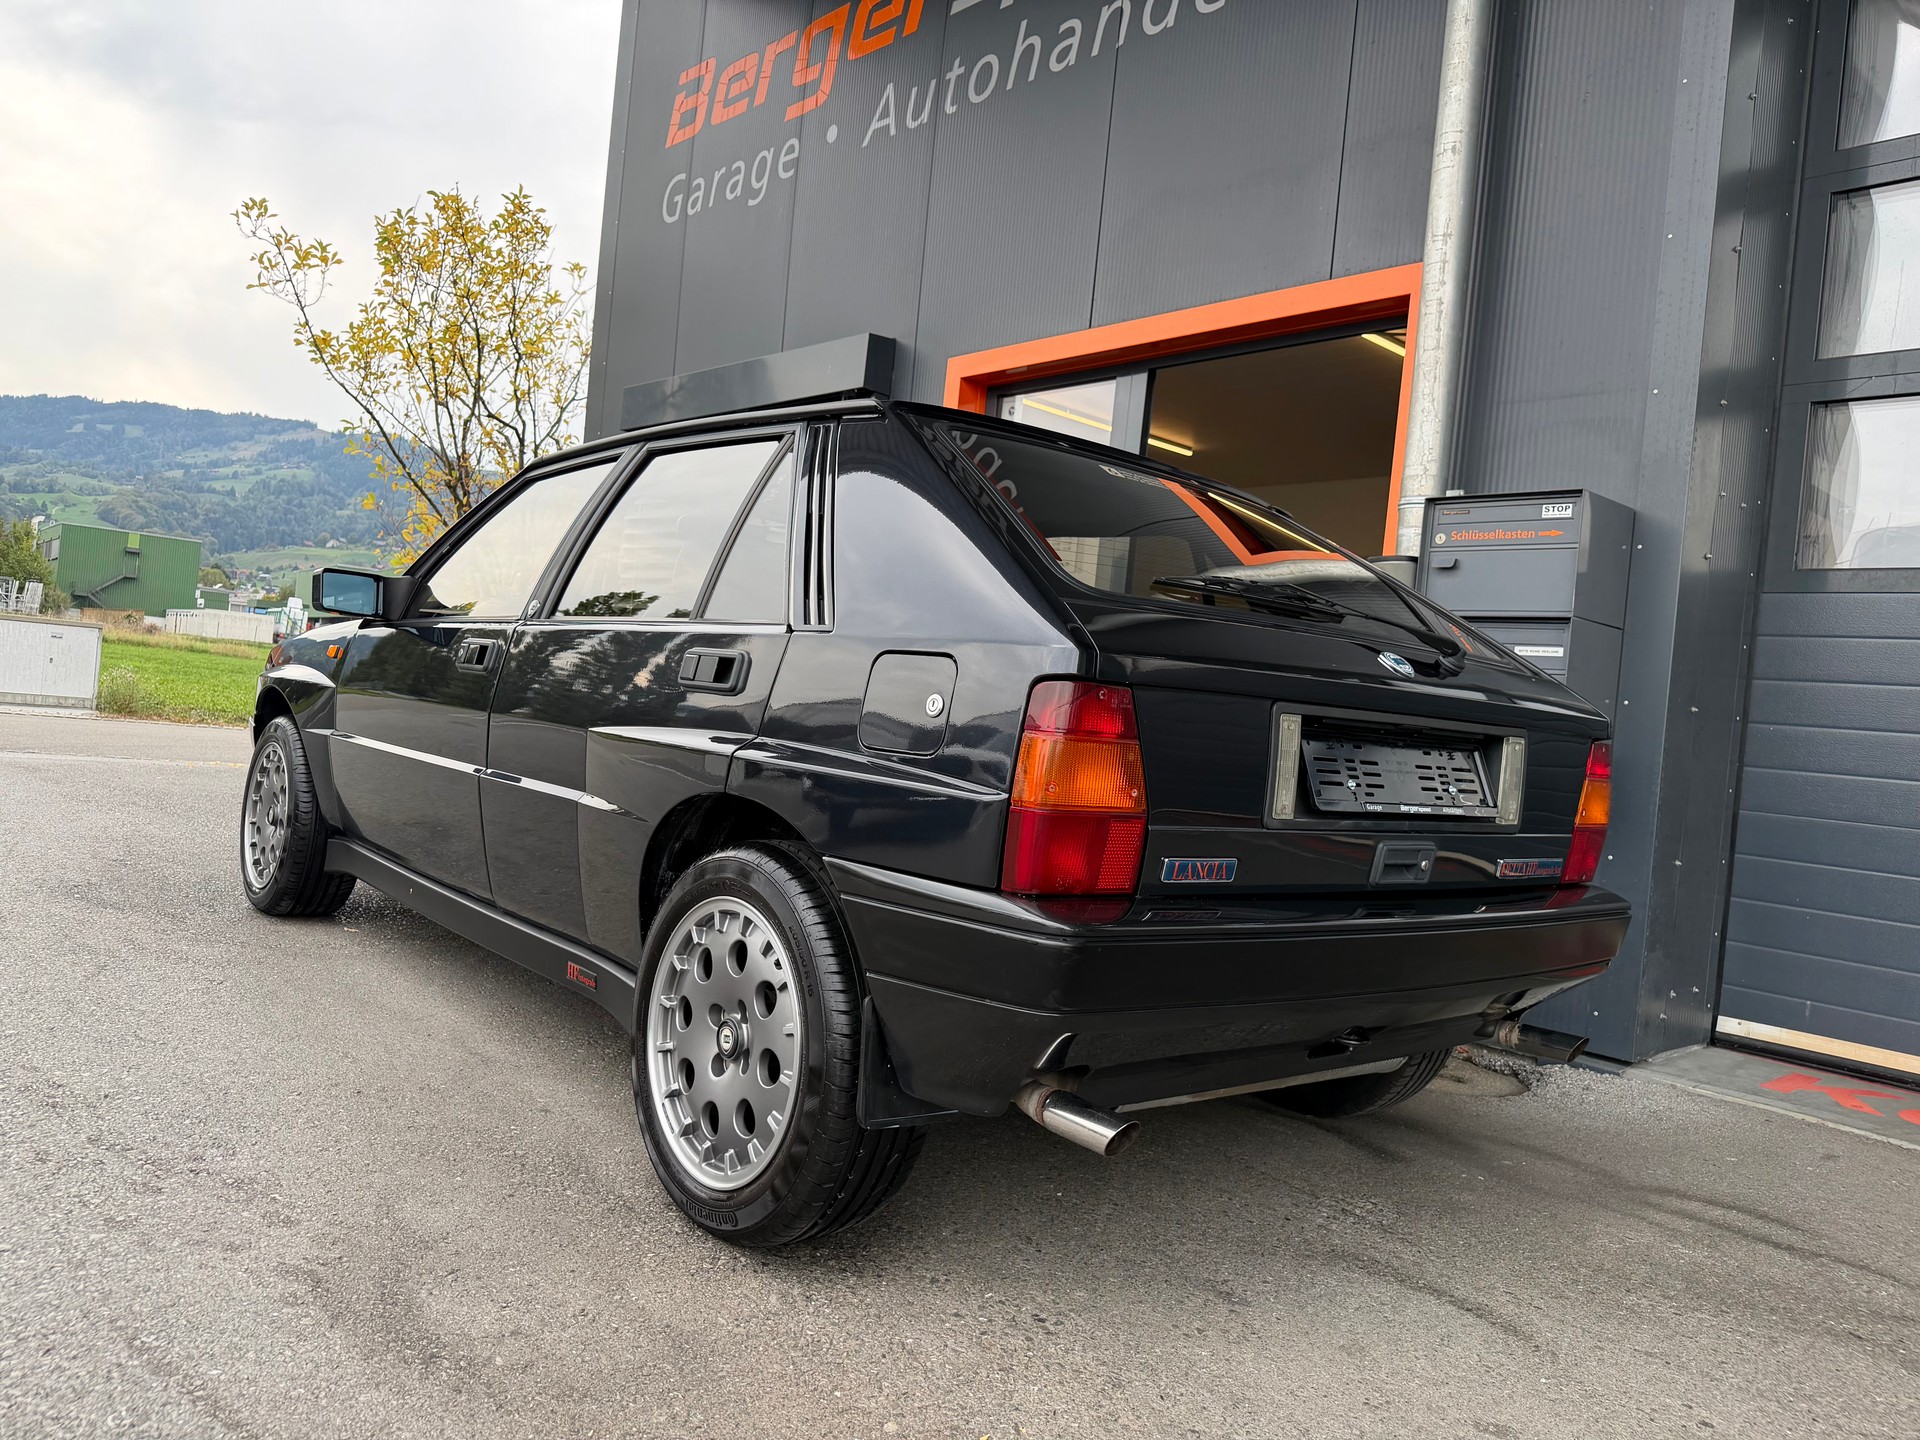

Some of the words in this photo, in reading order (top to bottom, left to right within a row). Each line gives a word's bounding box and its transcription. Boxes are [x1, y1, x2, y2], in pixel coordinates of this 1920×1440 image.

[661, 137, 801, 224] Garage
[1544, 505, 1571, 513] STOP
[1451, 529, 1535, 541] Schlüsselkasten
[1366, 804, 1383, 812] Garage
[1172, 861, 1227, 880] LANCIA
